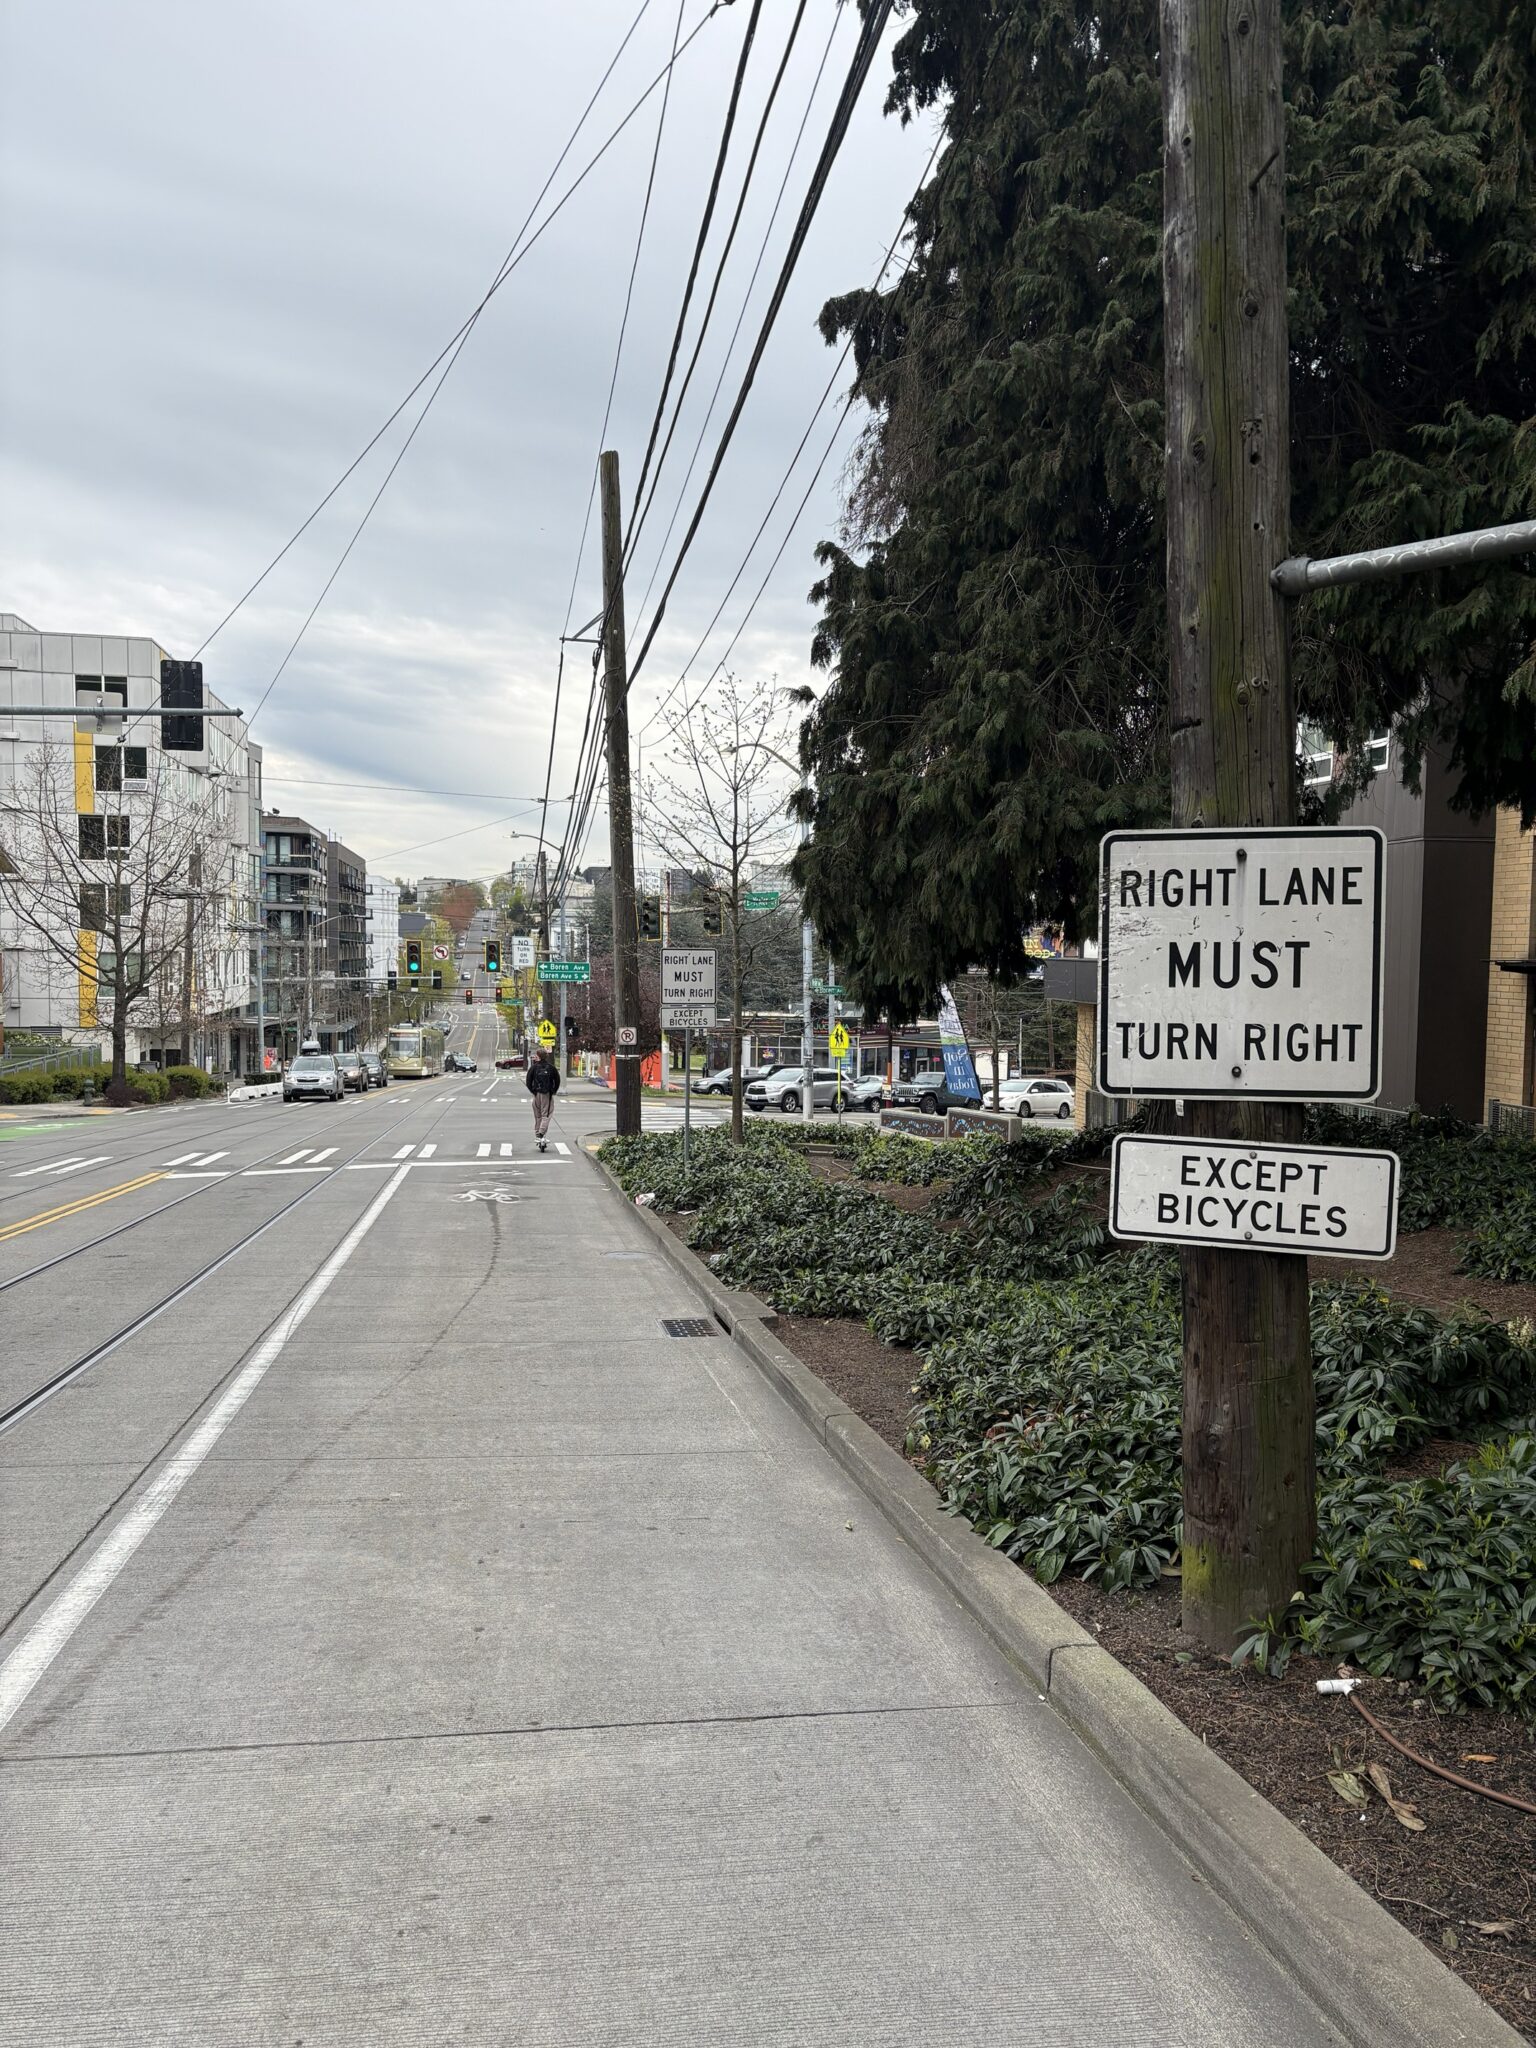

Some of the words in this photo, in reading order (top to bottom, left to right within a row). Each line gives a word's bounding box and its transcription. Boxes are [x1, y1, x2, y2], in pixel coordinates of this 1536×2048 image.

[1120, 868, 1236, 907] RIGHT
[1259, 866, 1363, 906] LANE
[664, 955, 688, 965] RIGHT
[692, 956, 714, 965] LANE
[1168, 940, 1311, 989] MUST
[674, 971, 704, 982] MUST
[664, 988, 686, 998] TURN
[689, 988, 714, 998] RIGHT
[669, 1018, 708, 1026] BICYCLES
[673, 1009, 704, 1018] EXCEPT
[1116, 1022, 1218, 1060] TURN
[1244, 1023, 1363, 1062] RIGHT
[1180, 1155, 1328, 1195] EXCEPT
[1157, 1192, 1347, 1238] BICYCLES
